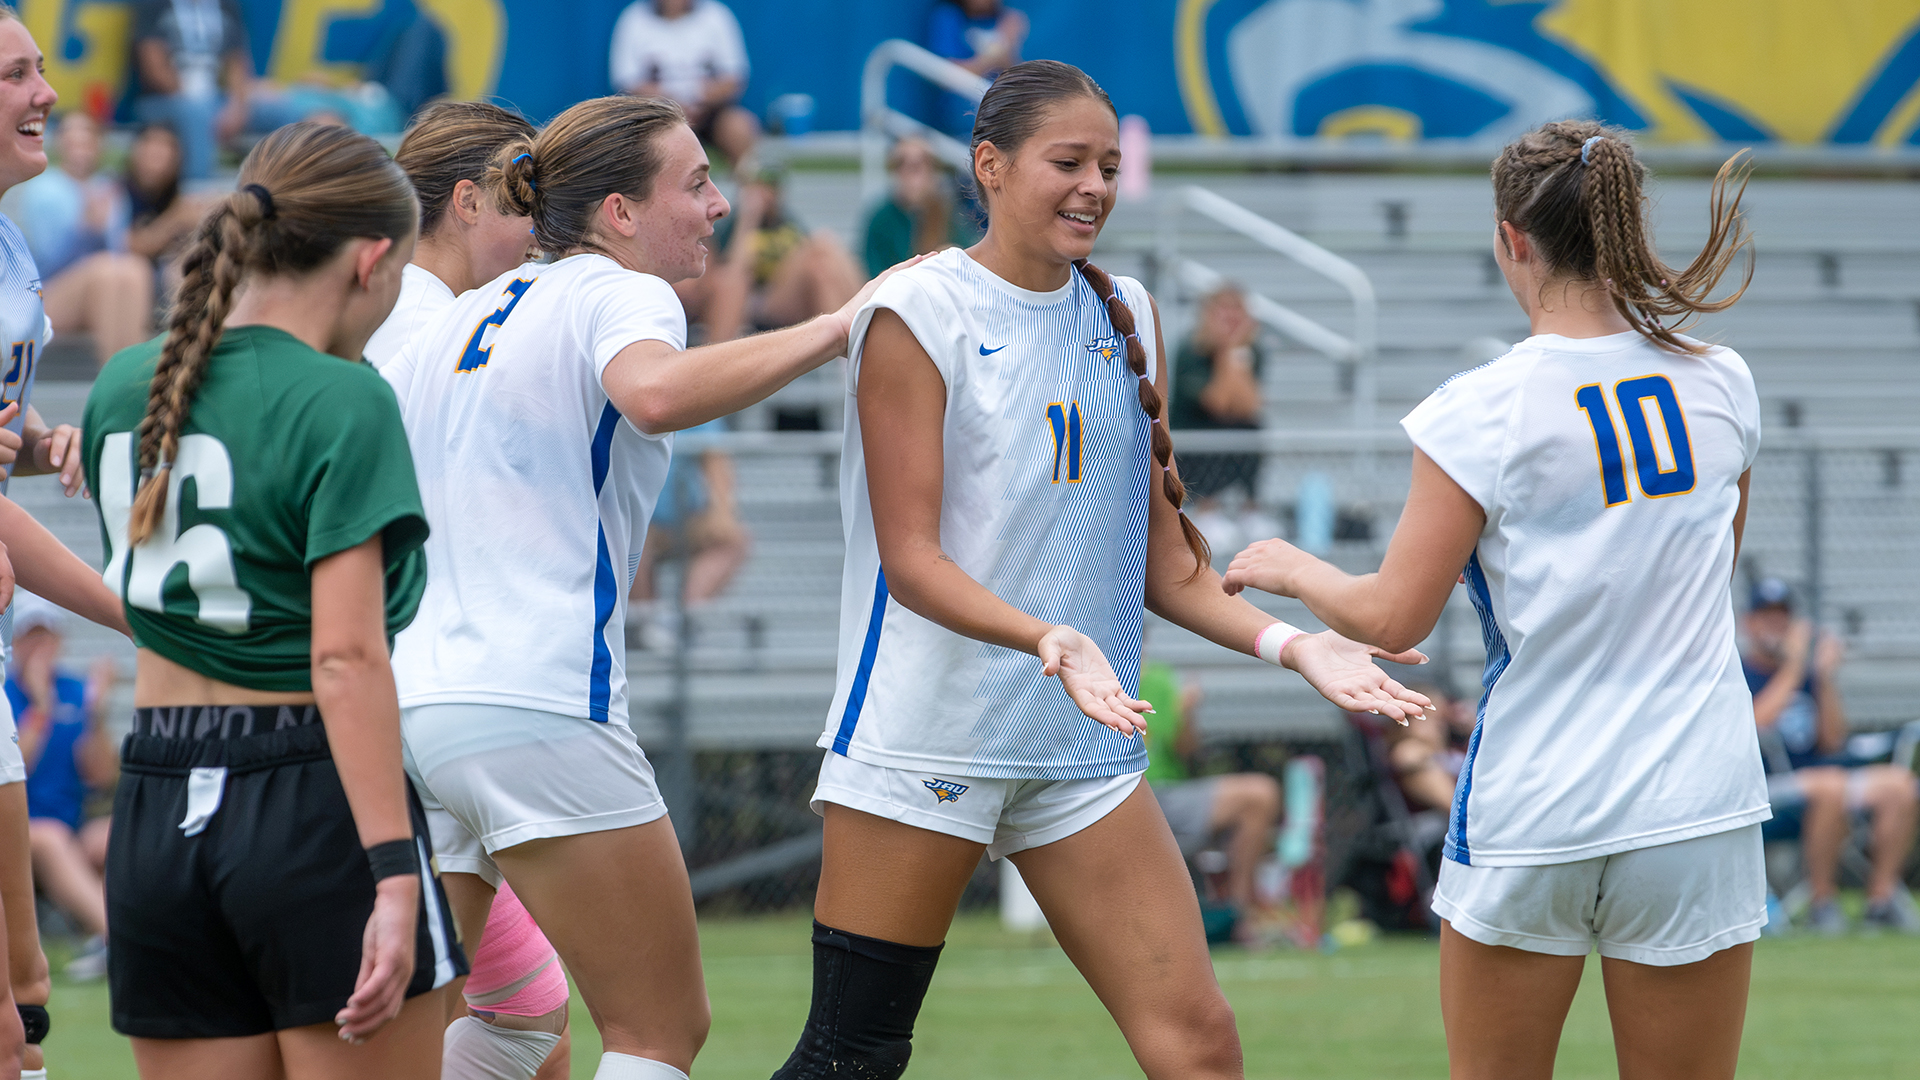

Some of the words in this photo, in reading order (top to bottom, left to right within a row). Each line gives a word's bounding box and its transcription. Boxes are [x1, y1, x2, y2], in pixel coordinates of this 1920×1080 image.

[454, 276, 539, 374] 2
[1045, 400, 1083, 484] 11
[1574, 373, 1698, 508] 10
[99, 431, 252, 634] 16
